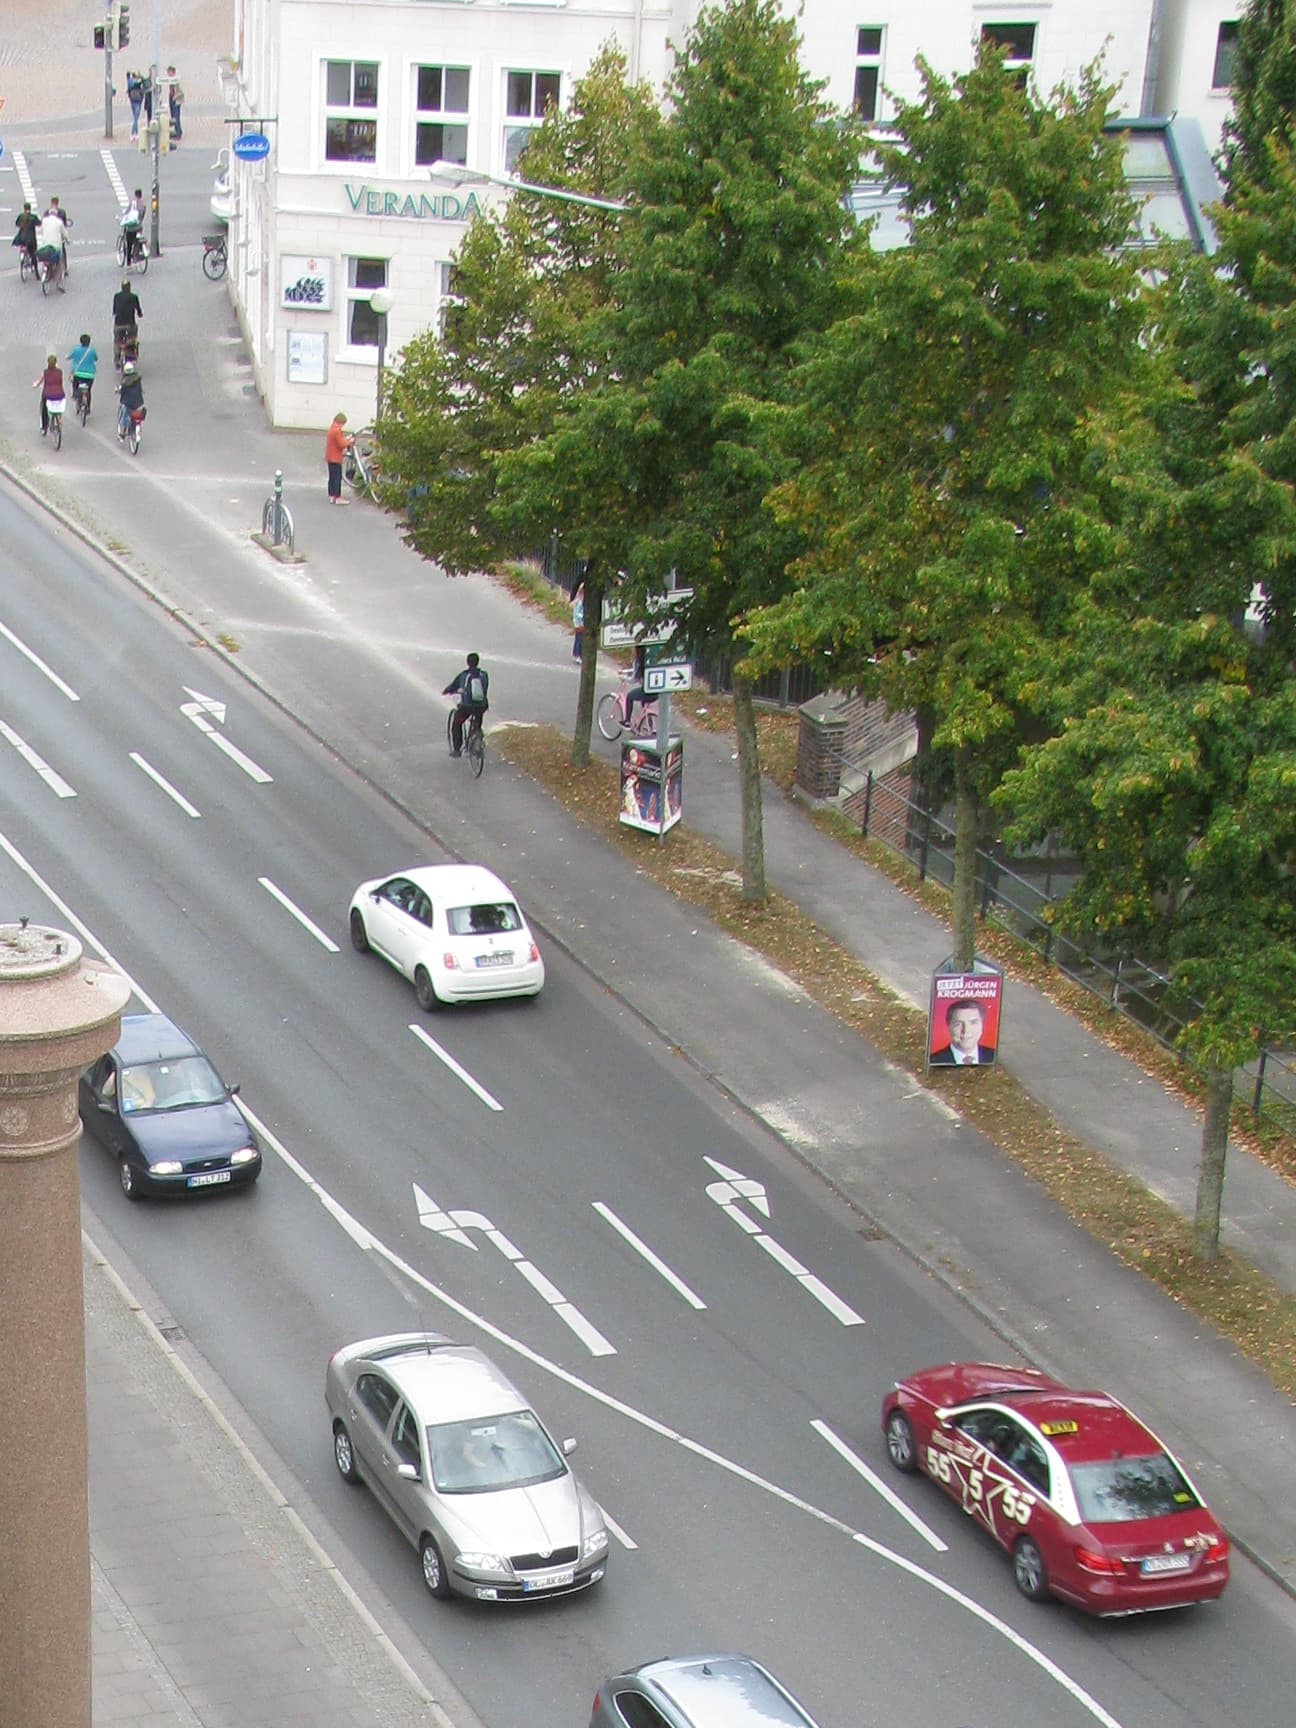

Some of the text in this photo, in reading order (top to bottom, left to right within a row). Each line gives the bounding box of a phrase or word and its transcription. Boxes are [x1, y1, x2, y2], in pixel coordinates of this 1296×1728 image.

[343, 183, 483, 219] VERANDA
[964, 980, 997, 989] JÜRGEN
[937, 990, 997, 998] KROGMANN
